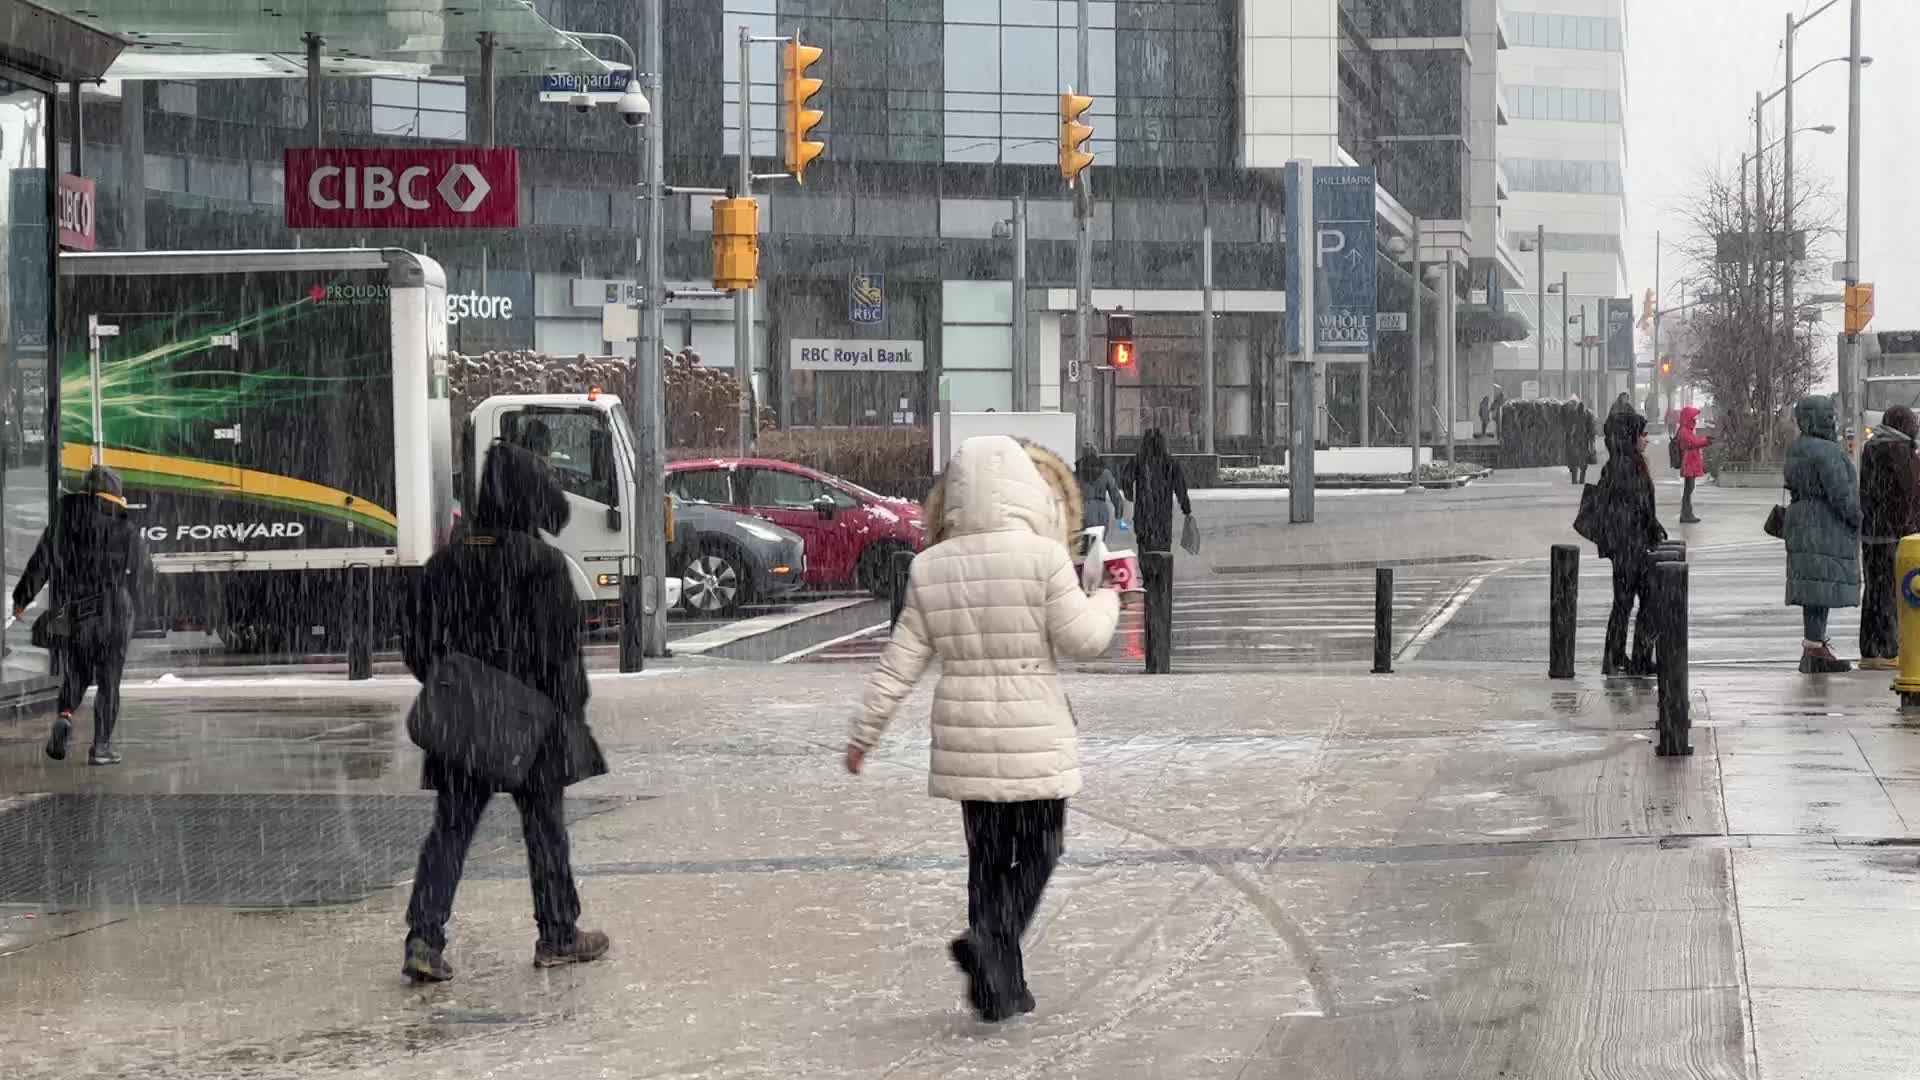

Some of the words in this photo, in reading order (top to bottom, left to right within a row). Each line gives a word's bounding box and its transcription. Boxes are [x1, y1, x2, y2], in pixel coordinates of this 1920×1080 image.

[551, 74, 611, 89] Sheppard
[308, 165, 431, 210] CIBC
[1317, 229, 1346, 268] P
[327, 284, 391, 298] PROUDLY
[853, 307, 881, 320] RBC
[1319, 314, 1372, 328] WHOLE
[1319, 327, 1369, 341] FOODS
[801, 347, 829, 362] RBC
[834, 347, 873, 366] Royal
[877, 347, 913, 362] Bank
[175, 522, 304, 543] FORWARD
